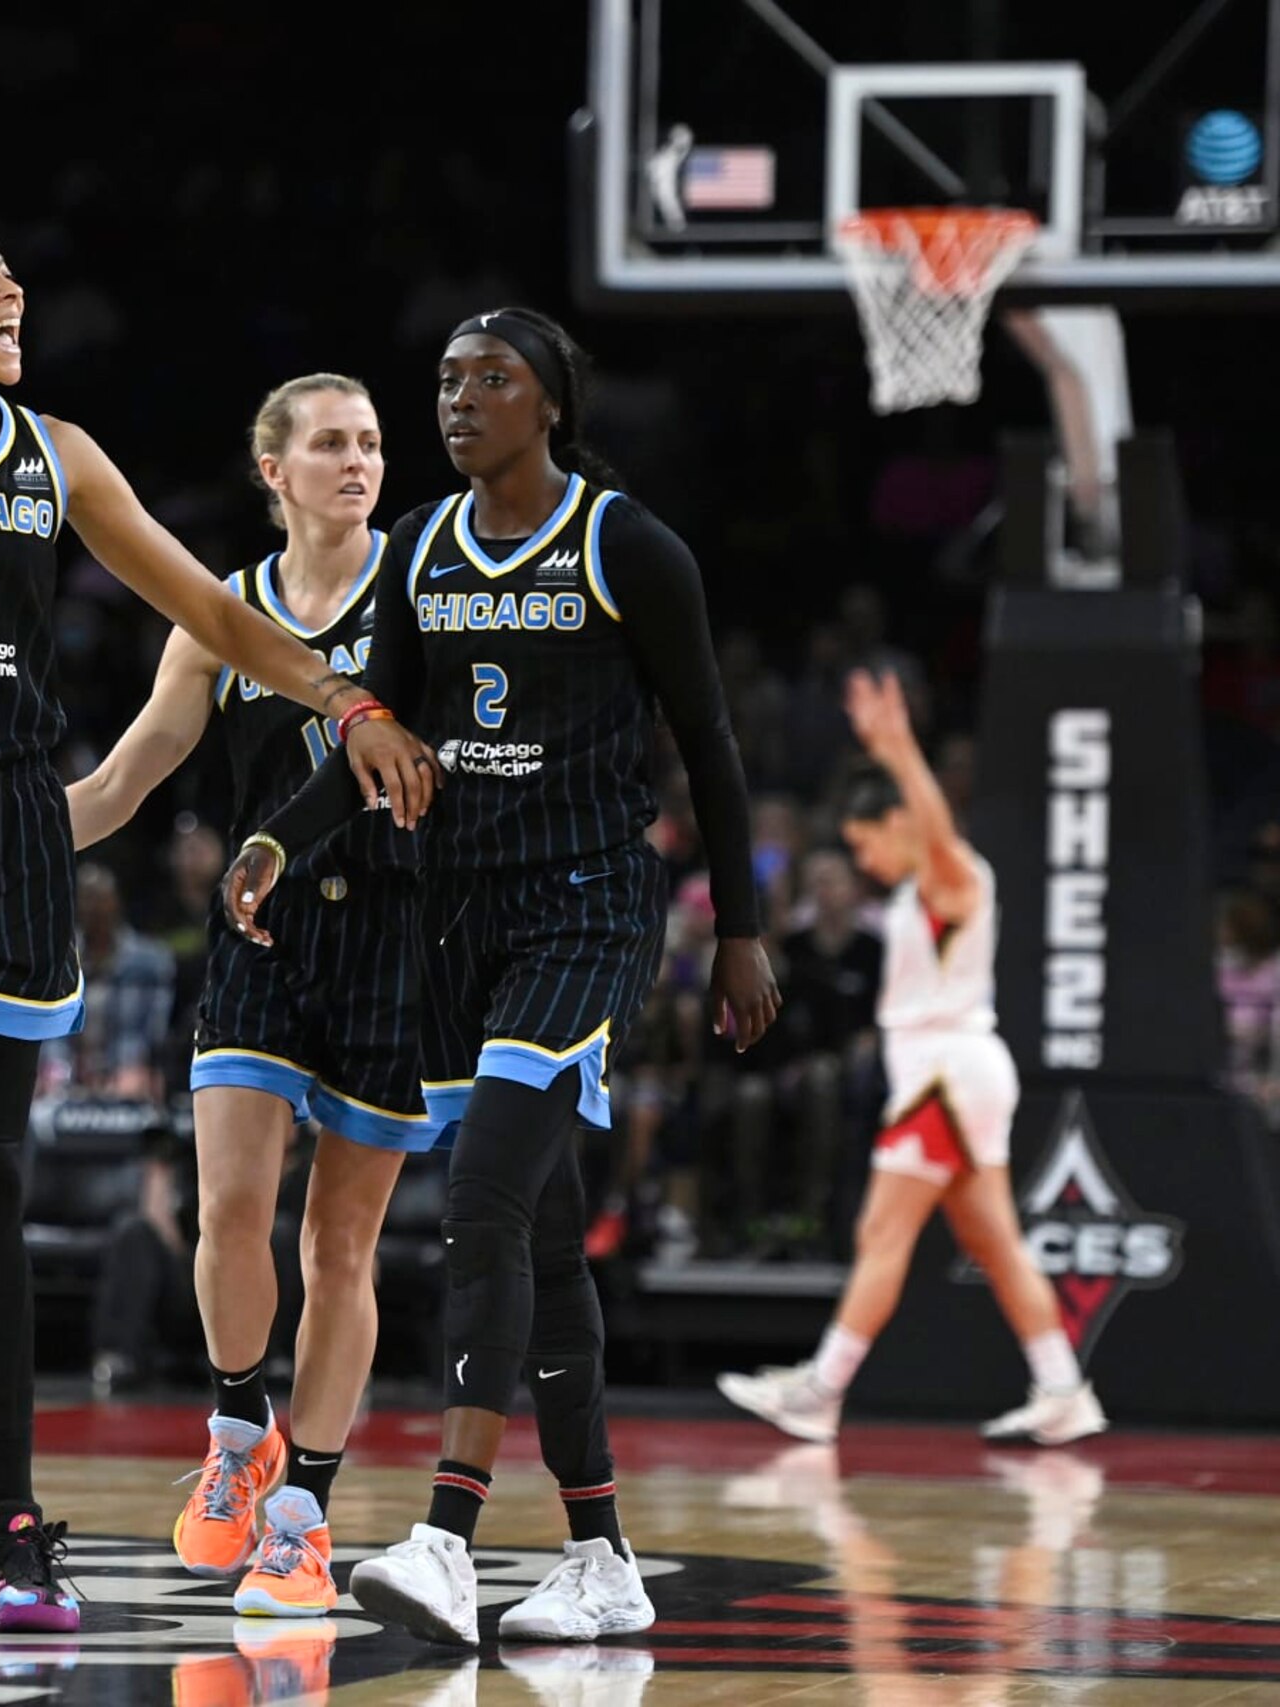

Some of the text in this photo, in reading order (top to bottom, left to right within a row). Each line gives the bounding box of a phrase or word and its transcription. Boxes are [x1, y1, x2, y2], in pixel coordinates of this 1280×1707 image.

[1175, 186, 1269, 225] AT&T
[417, 592, 586, 632] CHICAGO
[471, 663, 508, 729] 2
[460, 740, 544, 760] UChicago
[460, 759, 543, 778] Medicine
